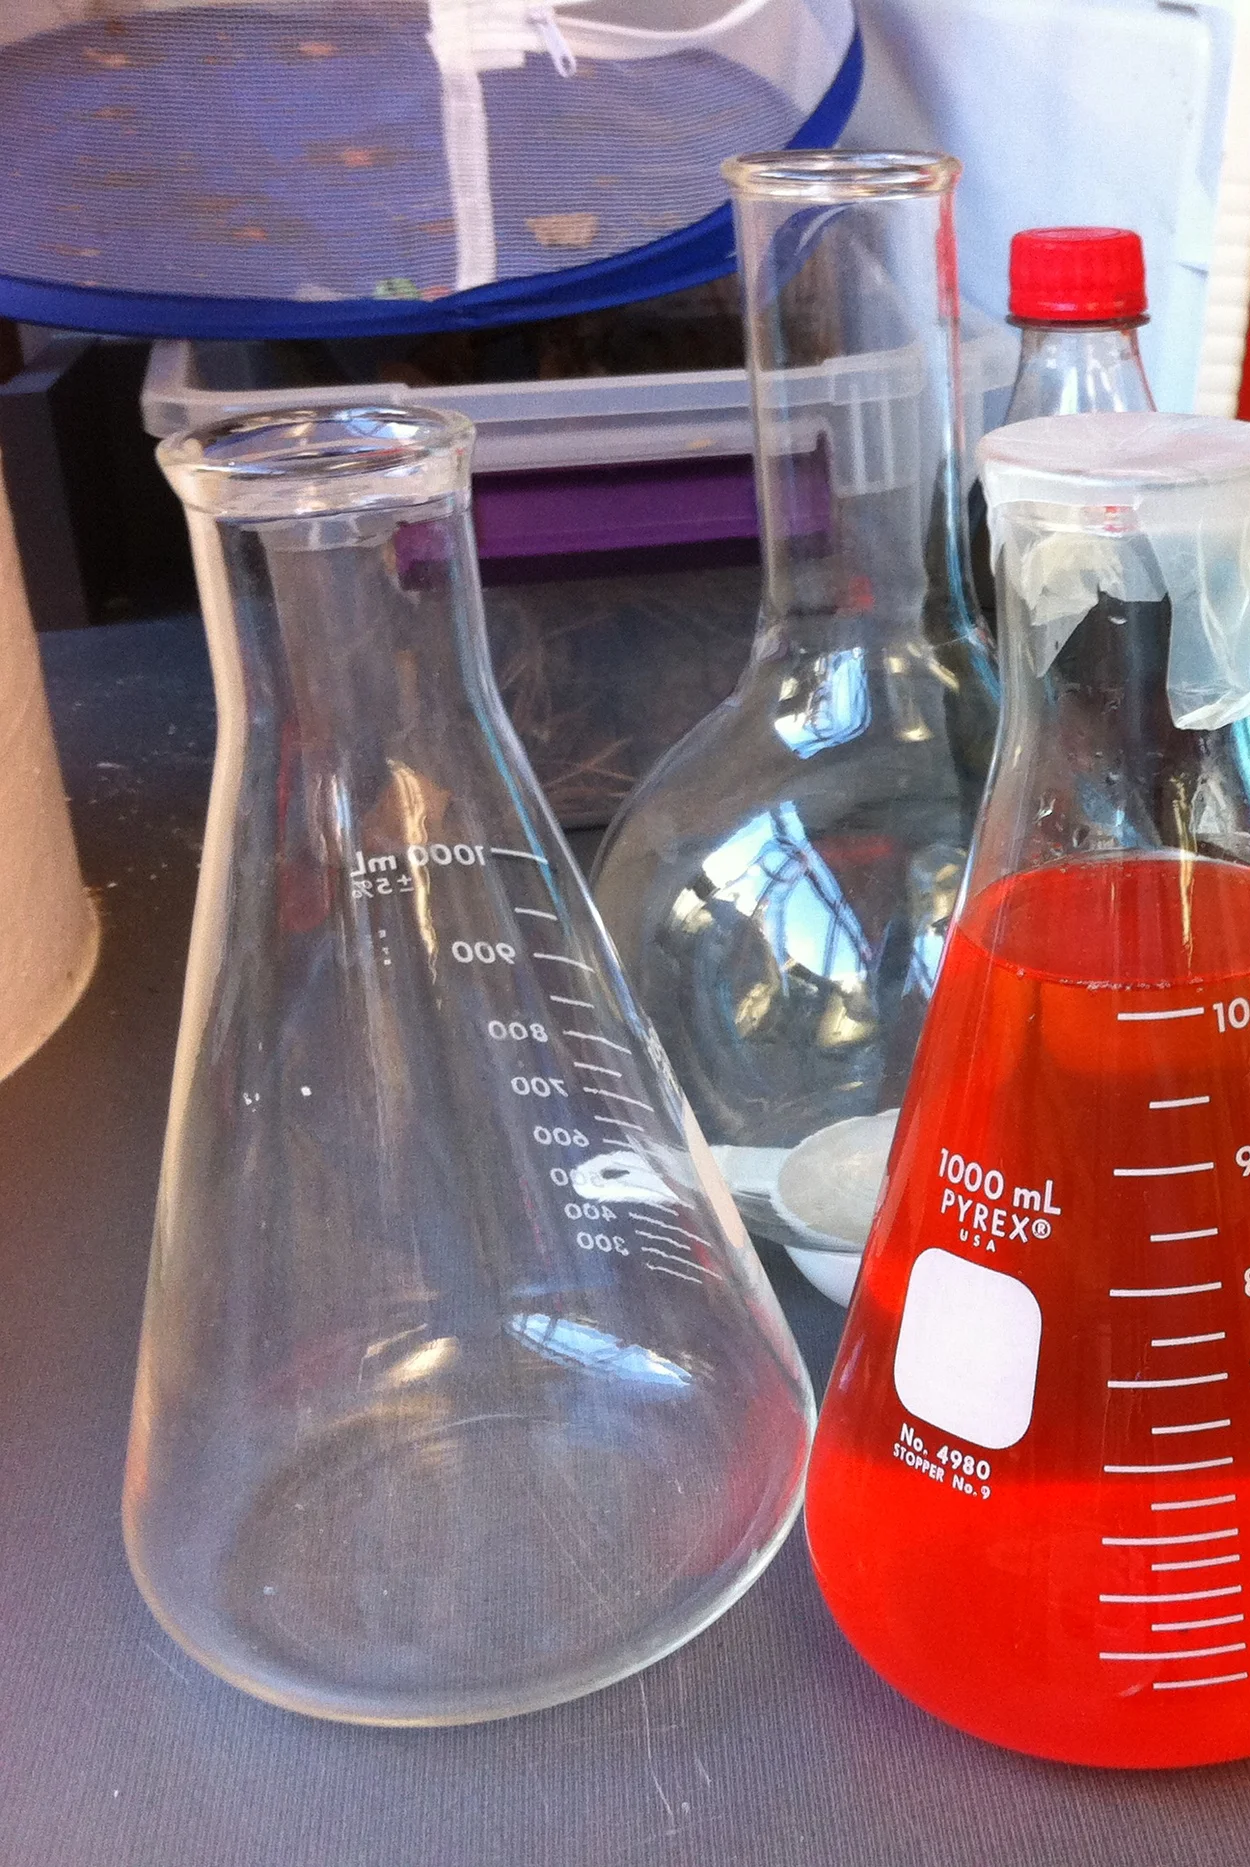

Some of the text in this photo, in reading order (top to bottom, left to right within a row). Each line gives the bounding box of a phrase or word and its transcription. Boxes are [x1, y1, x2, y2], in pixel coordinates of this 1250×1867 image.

[939, 1148, 1062, 1215] 1000 mL
[893, 1442, 991, 1500] STOPPER No. 9
[900, 1422, 991, 1481] No. 4980
